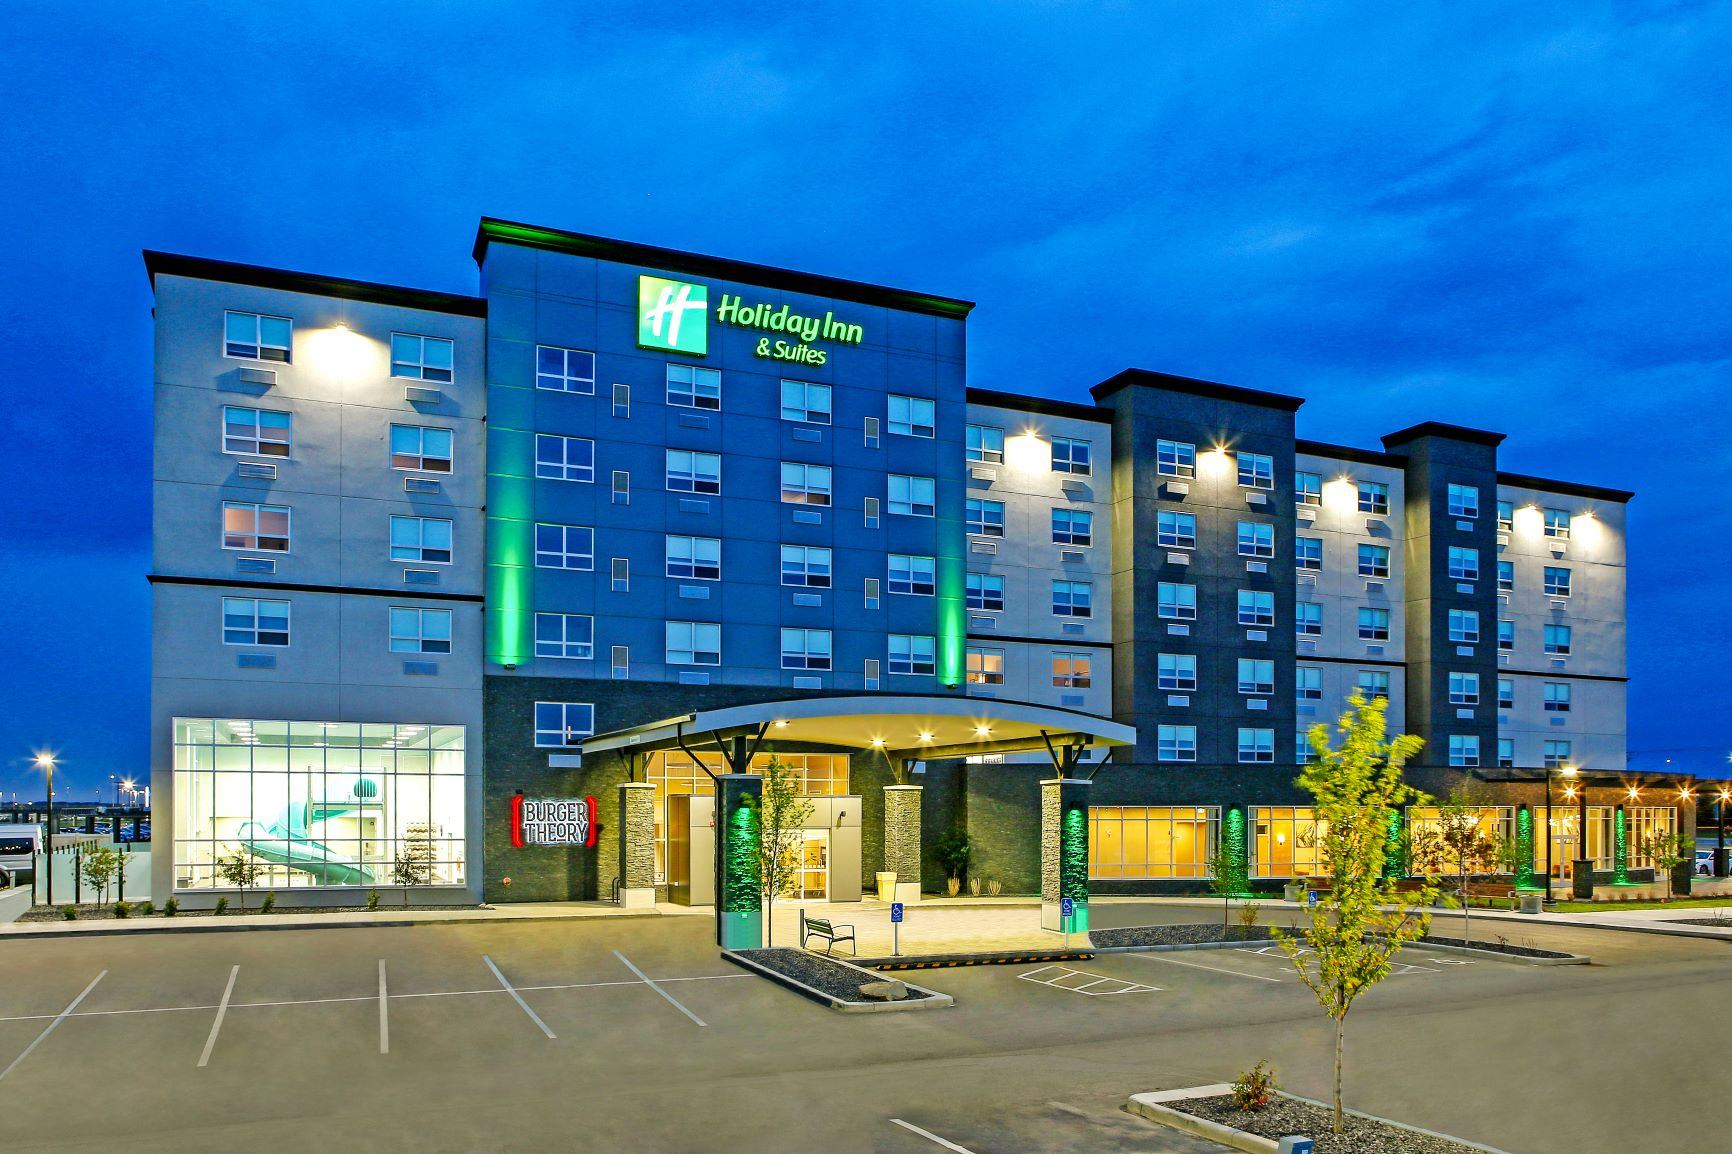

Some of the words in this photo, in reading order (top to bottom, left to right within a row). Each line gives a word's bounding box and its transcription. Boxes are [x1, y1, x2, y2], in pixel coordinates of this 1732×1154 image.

[717, 294, 820, 342] Holiday
[823, 311, 863, 344] Inn
[756, 337, 770, 356] &
[774, 340, 827, 365] Suites
[524, 801, 588, 822] BURGER
[524, 822, 588, 843] THEORY
